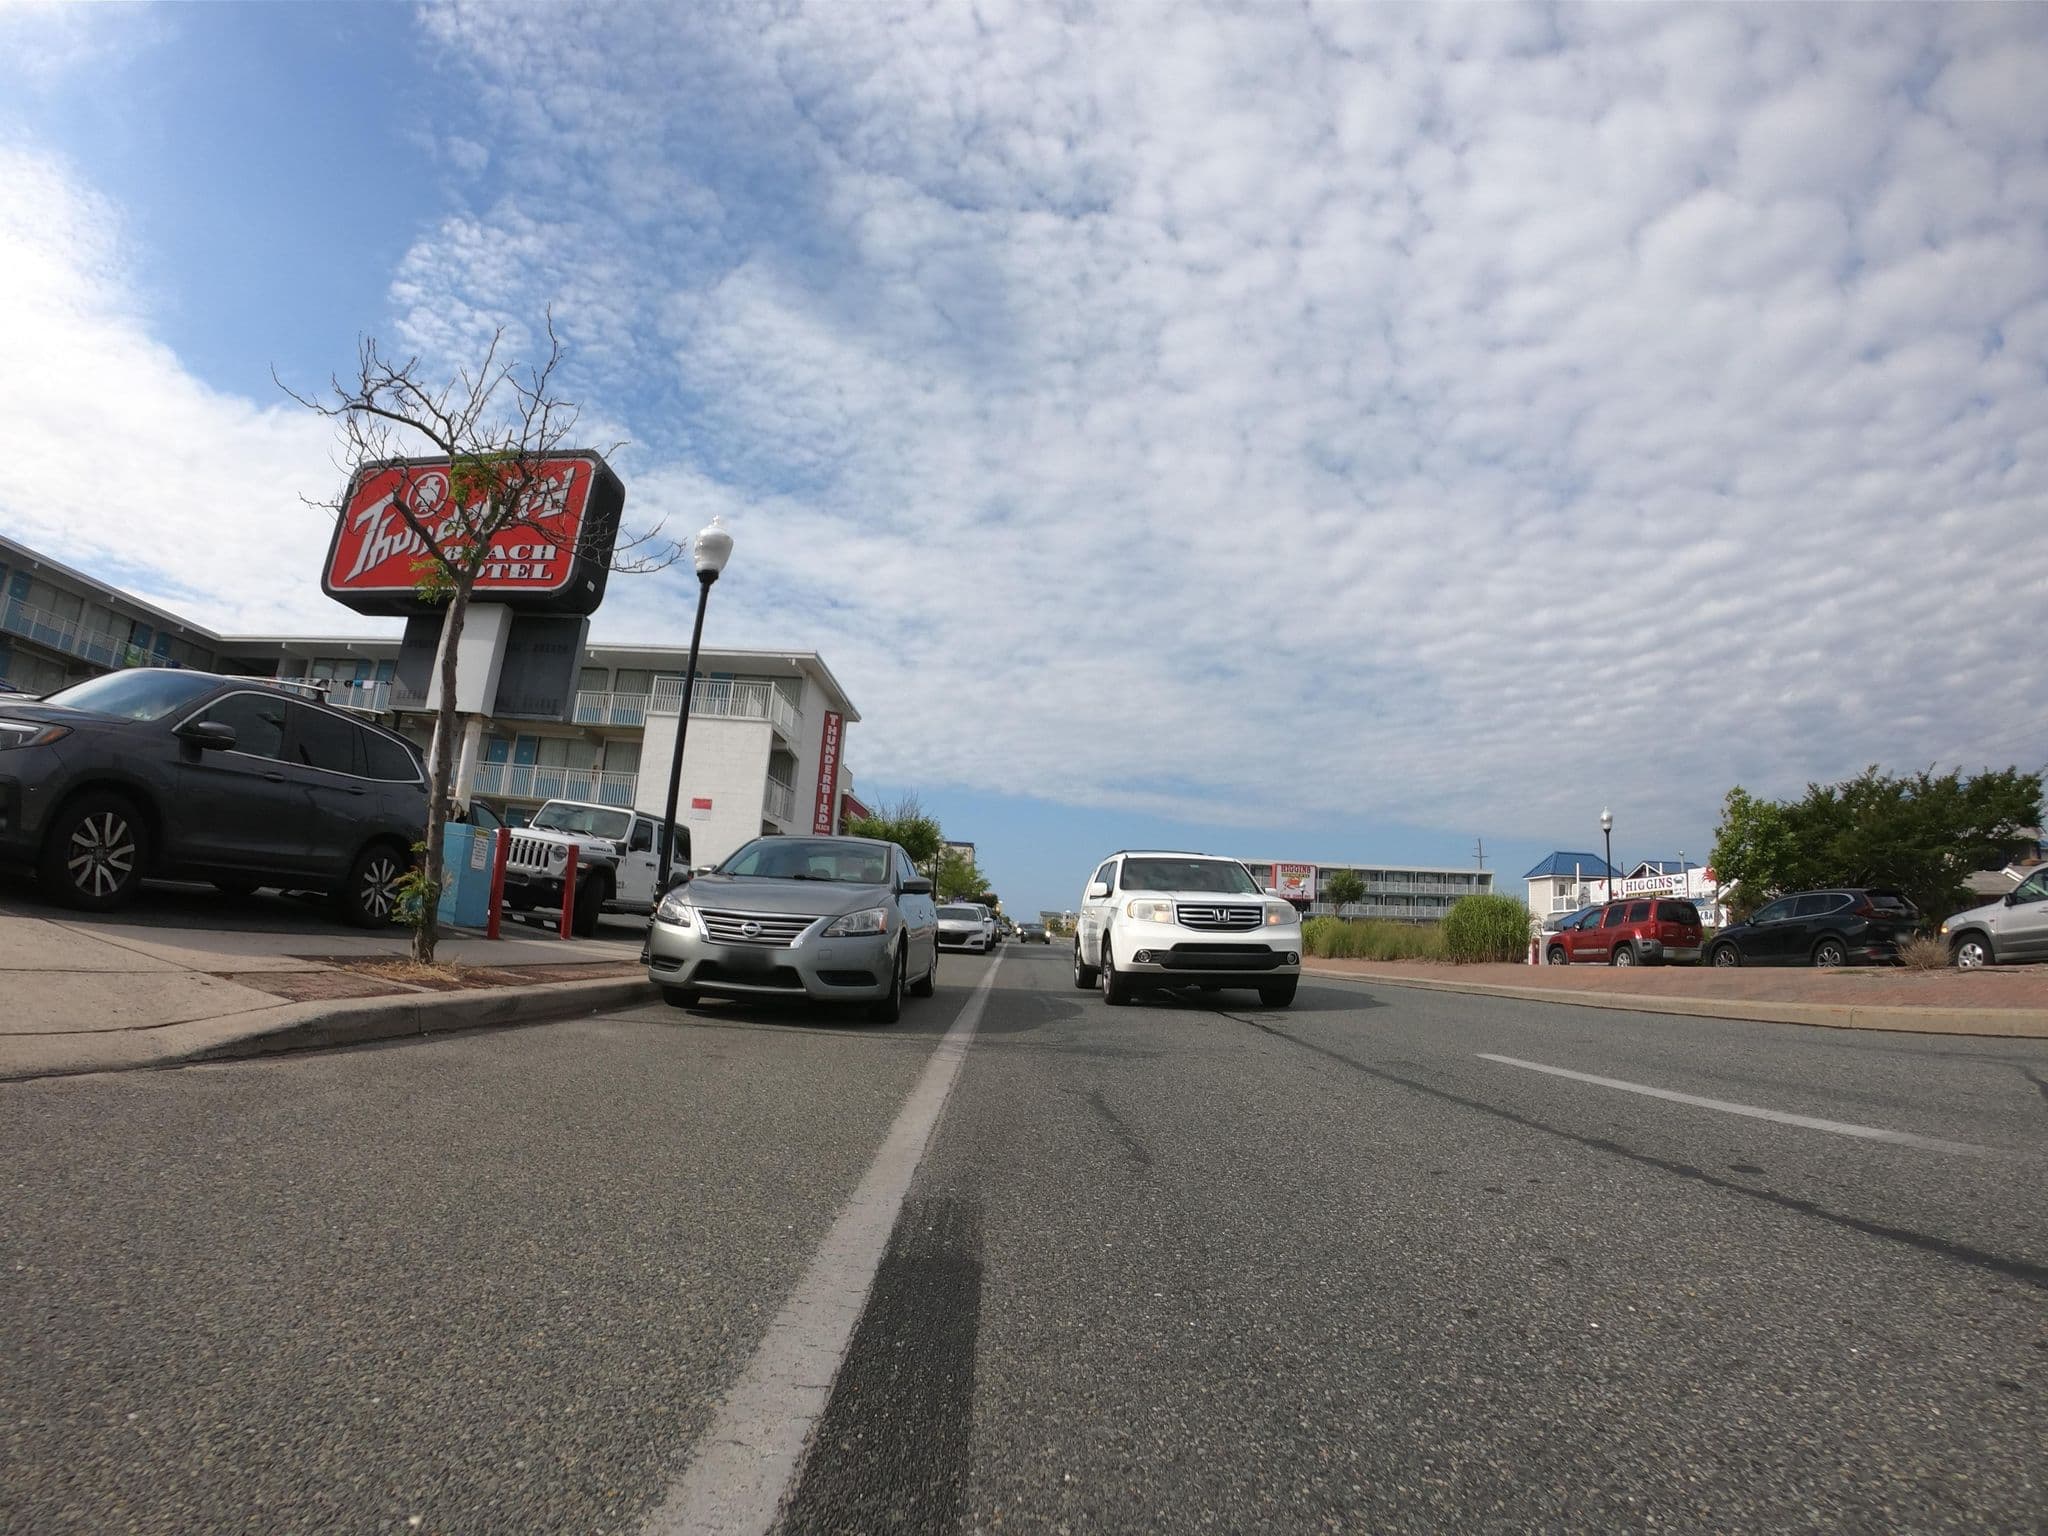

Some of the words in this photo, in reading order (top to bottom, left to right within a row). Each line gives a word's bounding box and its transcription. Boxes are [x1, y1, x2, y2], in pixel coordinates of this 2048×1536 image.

[443, 544, 557, 560] BACH
[818, 714, 838, 824] THUNDERBIRD
[1626, 877, 1673, 892] HIGGINS
